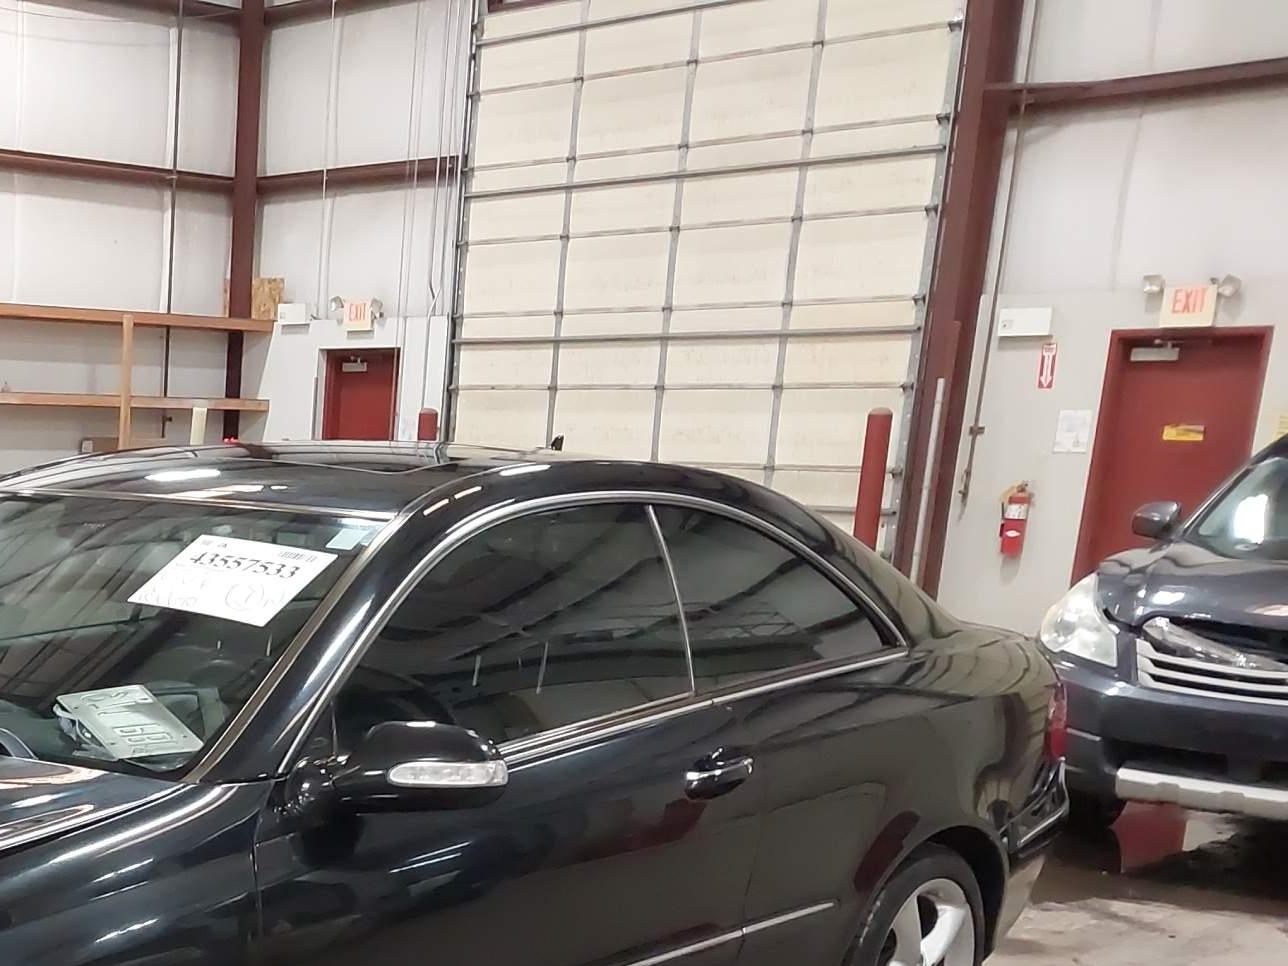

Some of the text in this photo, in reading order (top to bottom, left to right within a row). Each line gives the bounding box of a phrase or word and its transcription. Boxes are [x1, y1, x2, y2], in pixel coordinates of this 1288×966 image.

[349, 303, 367, 322] EXIT
[1172, 288, 1208, 313] EXIT
[189, 551, 301, 579] 43557533
